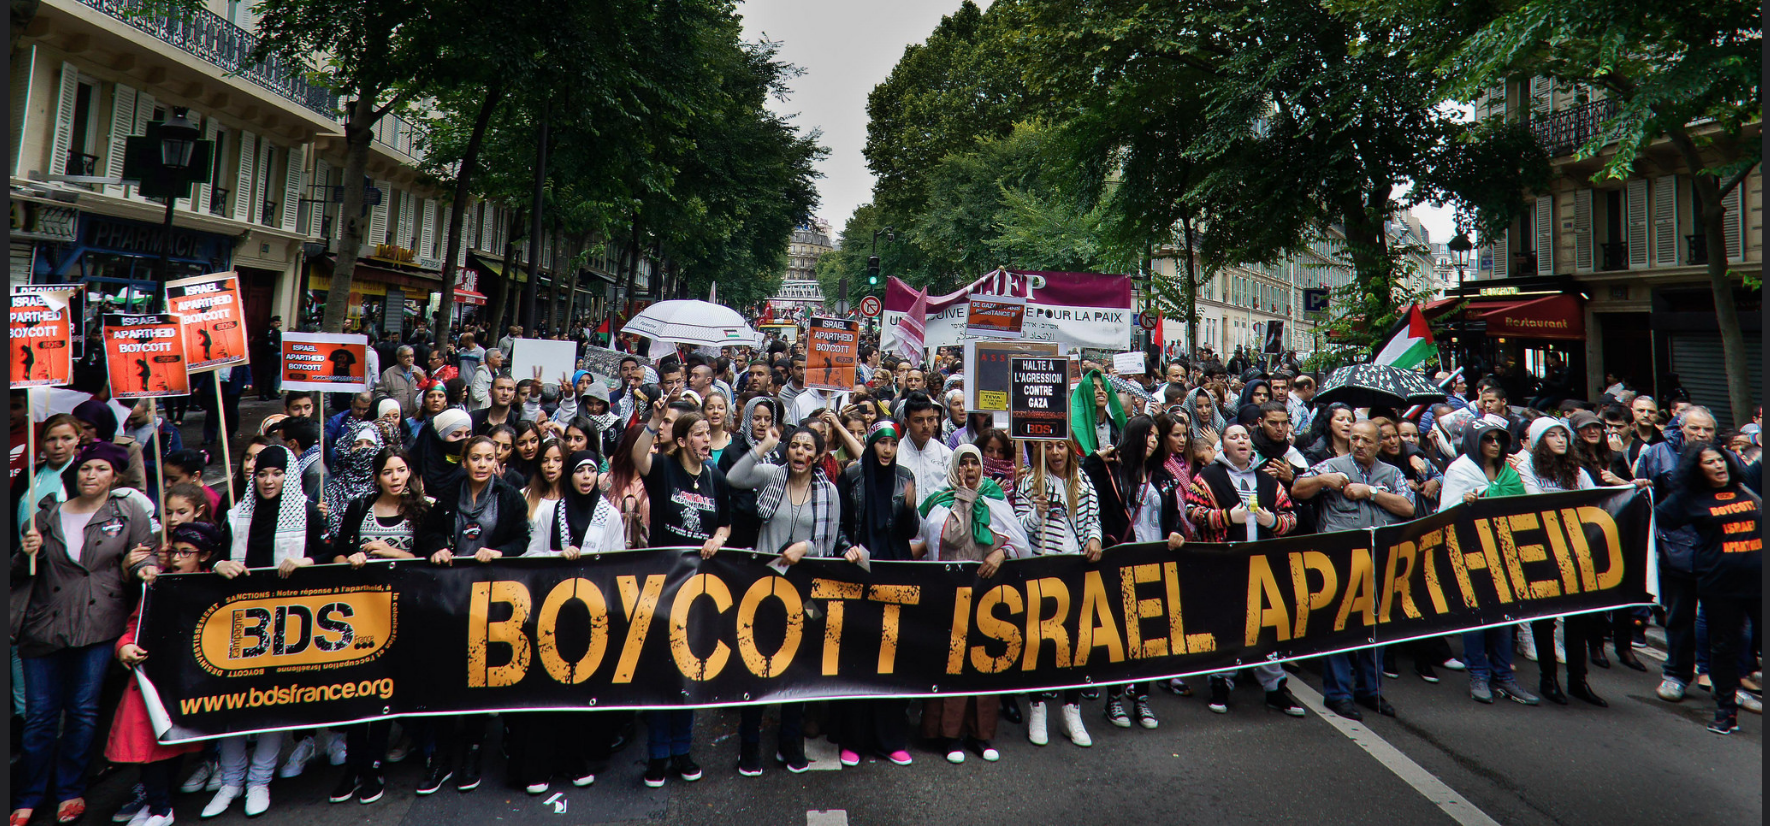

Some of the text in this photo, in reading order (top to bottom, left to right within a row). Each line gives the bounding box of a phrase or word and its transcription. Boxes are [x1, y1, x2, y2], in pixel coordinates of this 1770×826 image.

[183, 283, 220, 296] ISRAEL
[178, 294, 232, 311] APARTHEID
[1310, 293, 1320, 307] P
[10, 311, 61, 323] PARTHEID
[183, 309, 230, 325] BOYCOTT
[1037, 308, 1071, 320] POUR
[1075, 311, 1090, 321] LA
[1095, 312, 1122, 322] PAIX
[121, 316, 161, 326] ISRAEL
[822, 320, 846, 330] ISRAEL
[1505, 317, 1568, 328] Restaurant
[113, 328, 175, 339] APARTHEID
[814, 331, 853, 342] APARTHEID
[119, 342, 172, 353] BOYCOTT
[292, 344, 317, 352] ISRAEL
[816, 343, 849, 354] BOYCOTT
[286, 354, 325, 362] APARTHEID
[288, 363, 322, 371] BOYCOTT
[1022, 360, 1046, 371] HALTE
[1014, 372, 1062, 384] L'AGRESSION
[1024, 385, 1053, 396] CONTRE
[1028, 398, 1048, 408] GAZA
[225, 591, 270, 604] SANCTIONS
[301, 587, 332, 596] réponse
[386, 583, 392, 591] à
[467, 505, 1625, 688] BOYCOTT ISRAEL APARTHEID
[229, 602, 355, 661] BDS
[227, 668, 265, 678] BOYCOTT
[180, 677, 395, 716] www.bdsfrance.org
